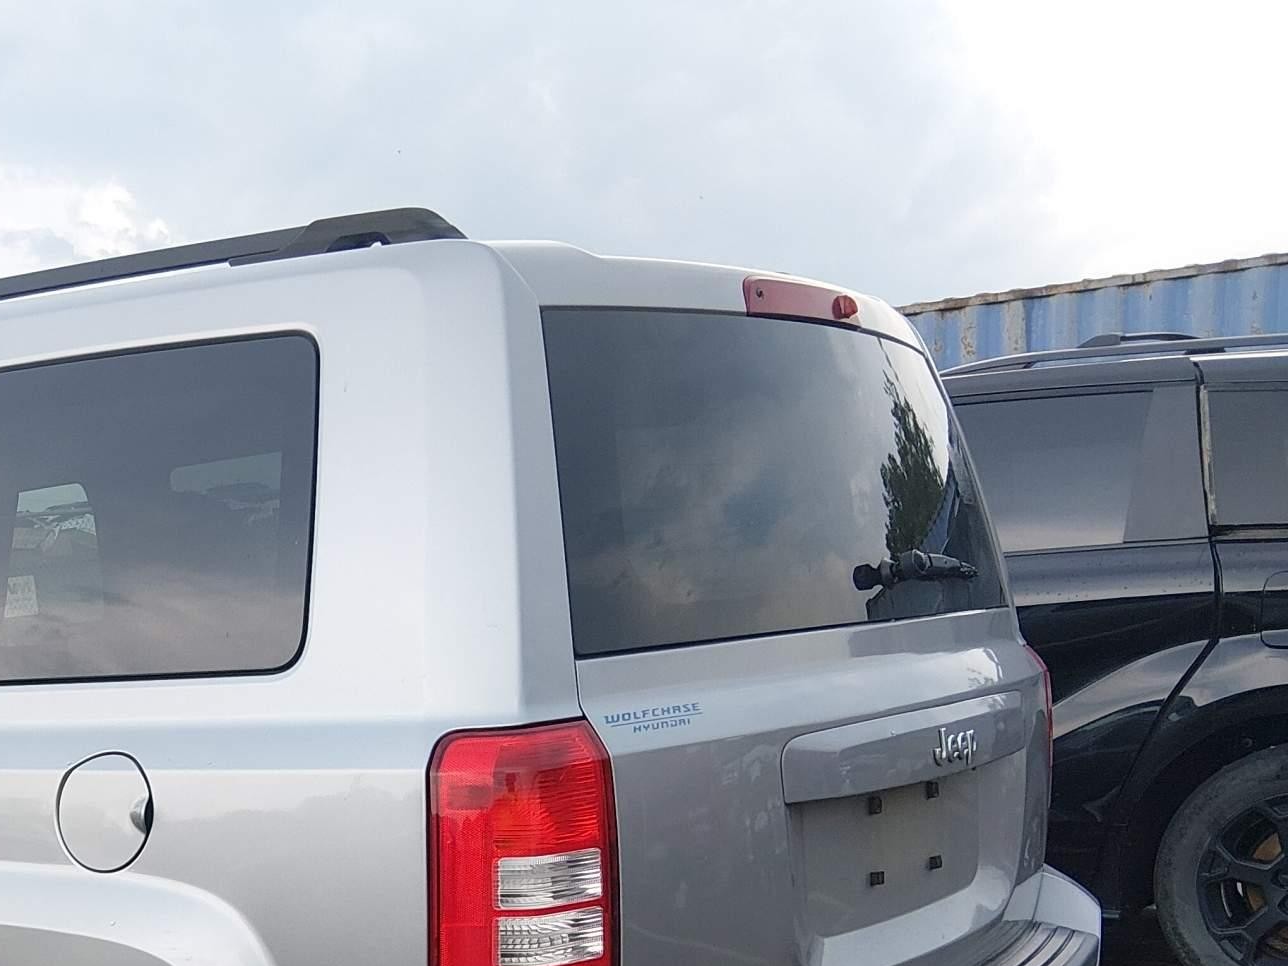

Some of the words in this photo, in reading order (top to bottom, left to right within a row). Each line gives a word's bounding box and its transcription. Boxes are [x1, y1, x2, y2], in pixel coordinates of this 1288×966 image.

[604, 702, 701, 725] WOLFCHASE
[633, 718, 691, 734] HYUNDAI
[933, 727, 977, 768] Jeep
